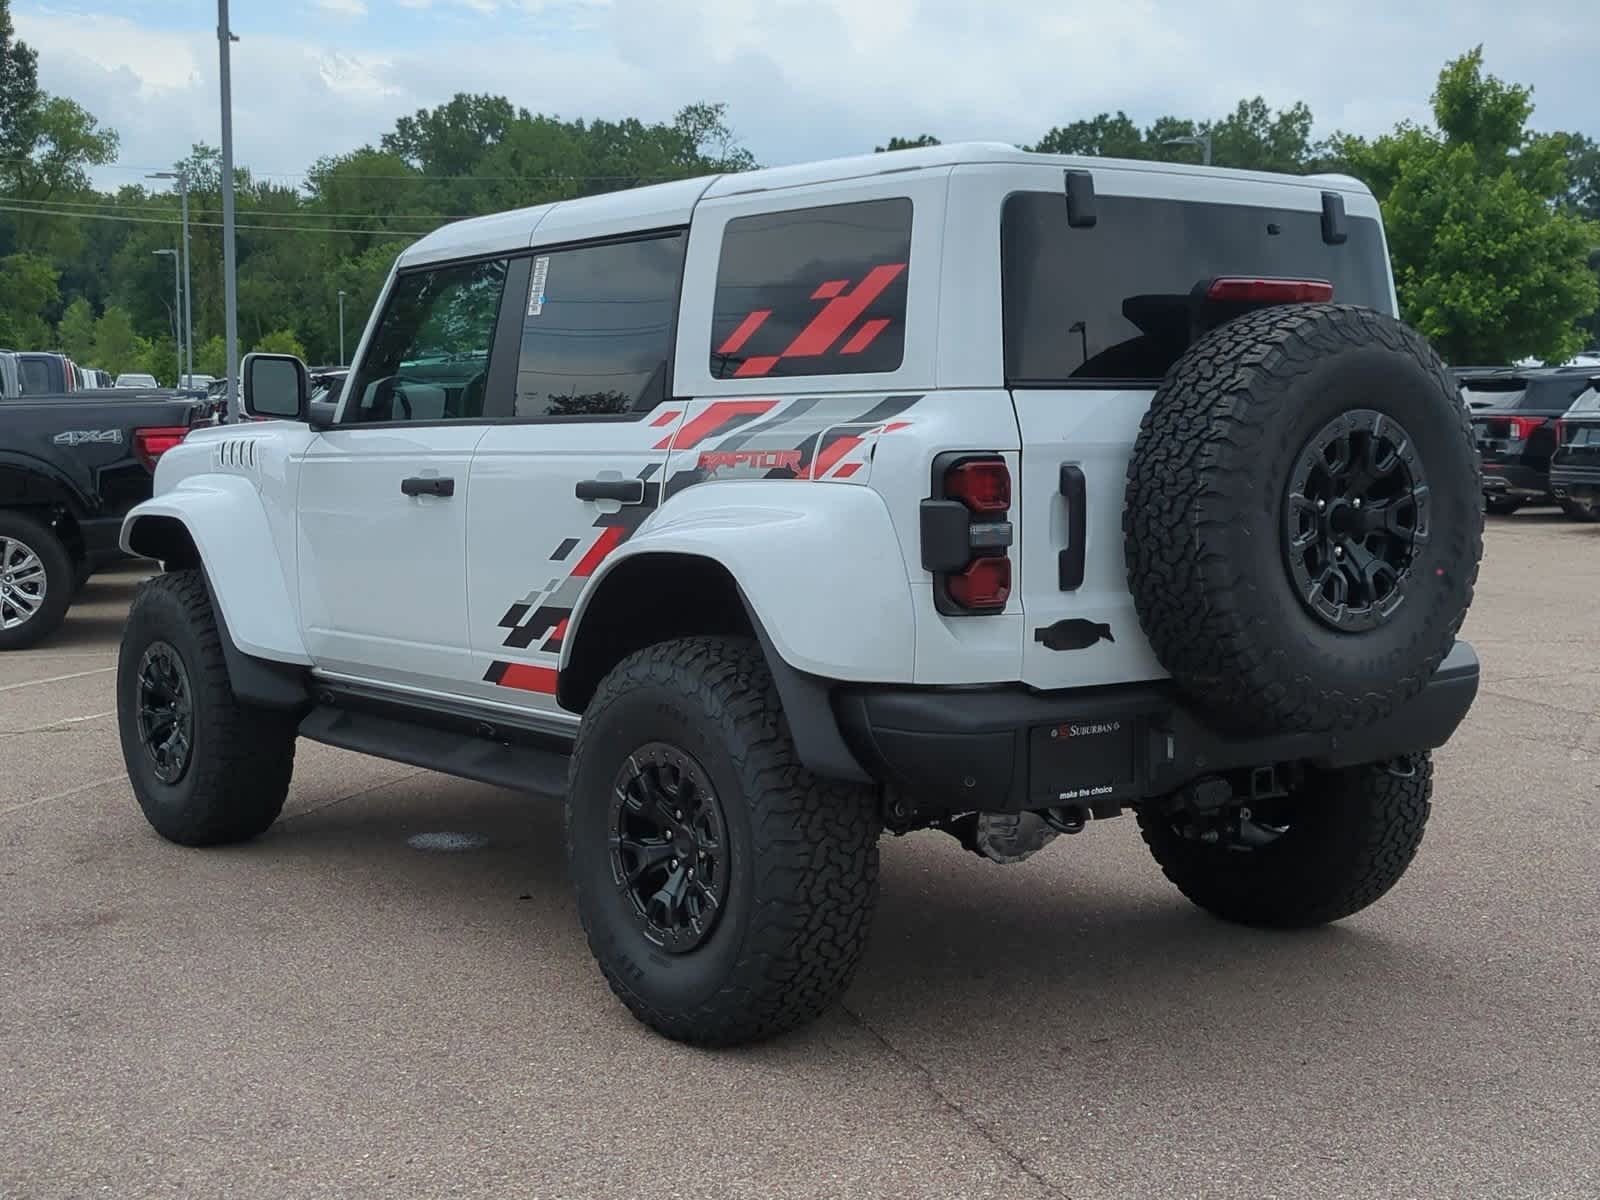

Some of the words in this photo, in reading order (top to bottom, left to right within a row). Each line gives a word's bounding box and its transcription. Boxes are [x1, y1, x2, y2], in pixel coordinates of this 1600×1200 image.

[698, 449, 802, 477] RAPTOR
[1059, 790, 1078, 800] make
[1079, 789, 1090, 797] the
[1091, 786, 1113, 795] choice
